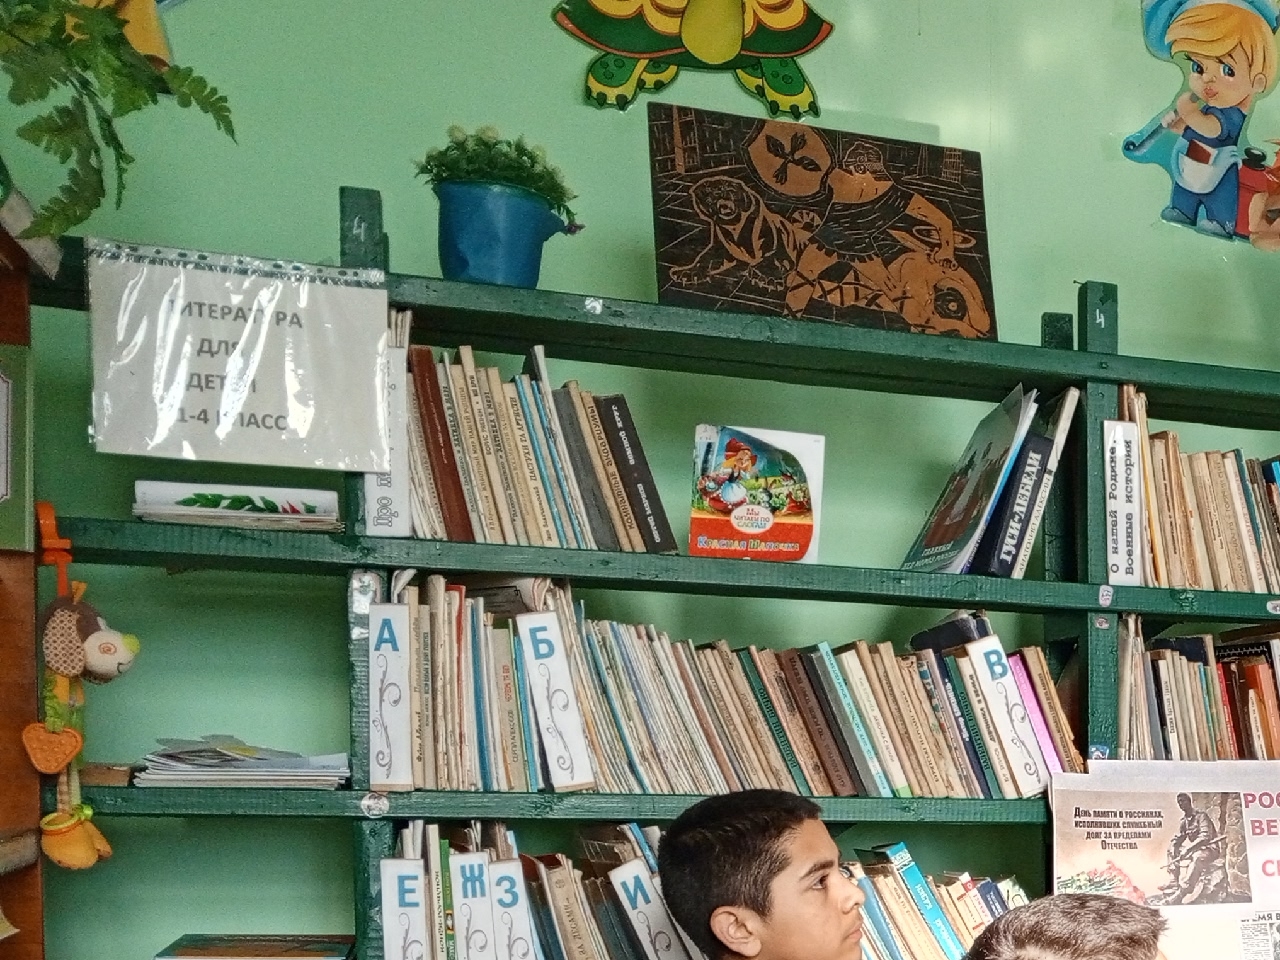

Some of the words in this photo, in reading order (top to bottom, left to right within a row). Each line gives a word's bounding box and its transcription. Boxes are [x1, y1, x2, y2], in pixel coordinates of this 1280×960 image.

[178, 408, 209, 424] 1-4
[1108, 439, 1118, 500] Родине.
[1124, 439, 1134, 503] истории
[372, 496, 398, 527] Про
[1109, 509, 1117, 554] нашей
[1124, 512, 1133, 575] Военные
[1110, 563, 1119, 573] О
[374, 618, 399, 652] А
[529, 626, 555, 660] Б
[984, 650, 1010, 680] В
[771, 720, 798, 768] ВАЛЕНТИН
[968, 723, 991, 770] ВАЛЕНТИН
[397, 875, 419, 908] Е
[460, 864, 486, 898] Ж
[496, 876, 519, 908] З
[620, 874, 652, 910] И
